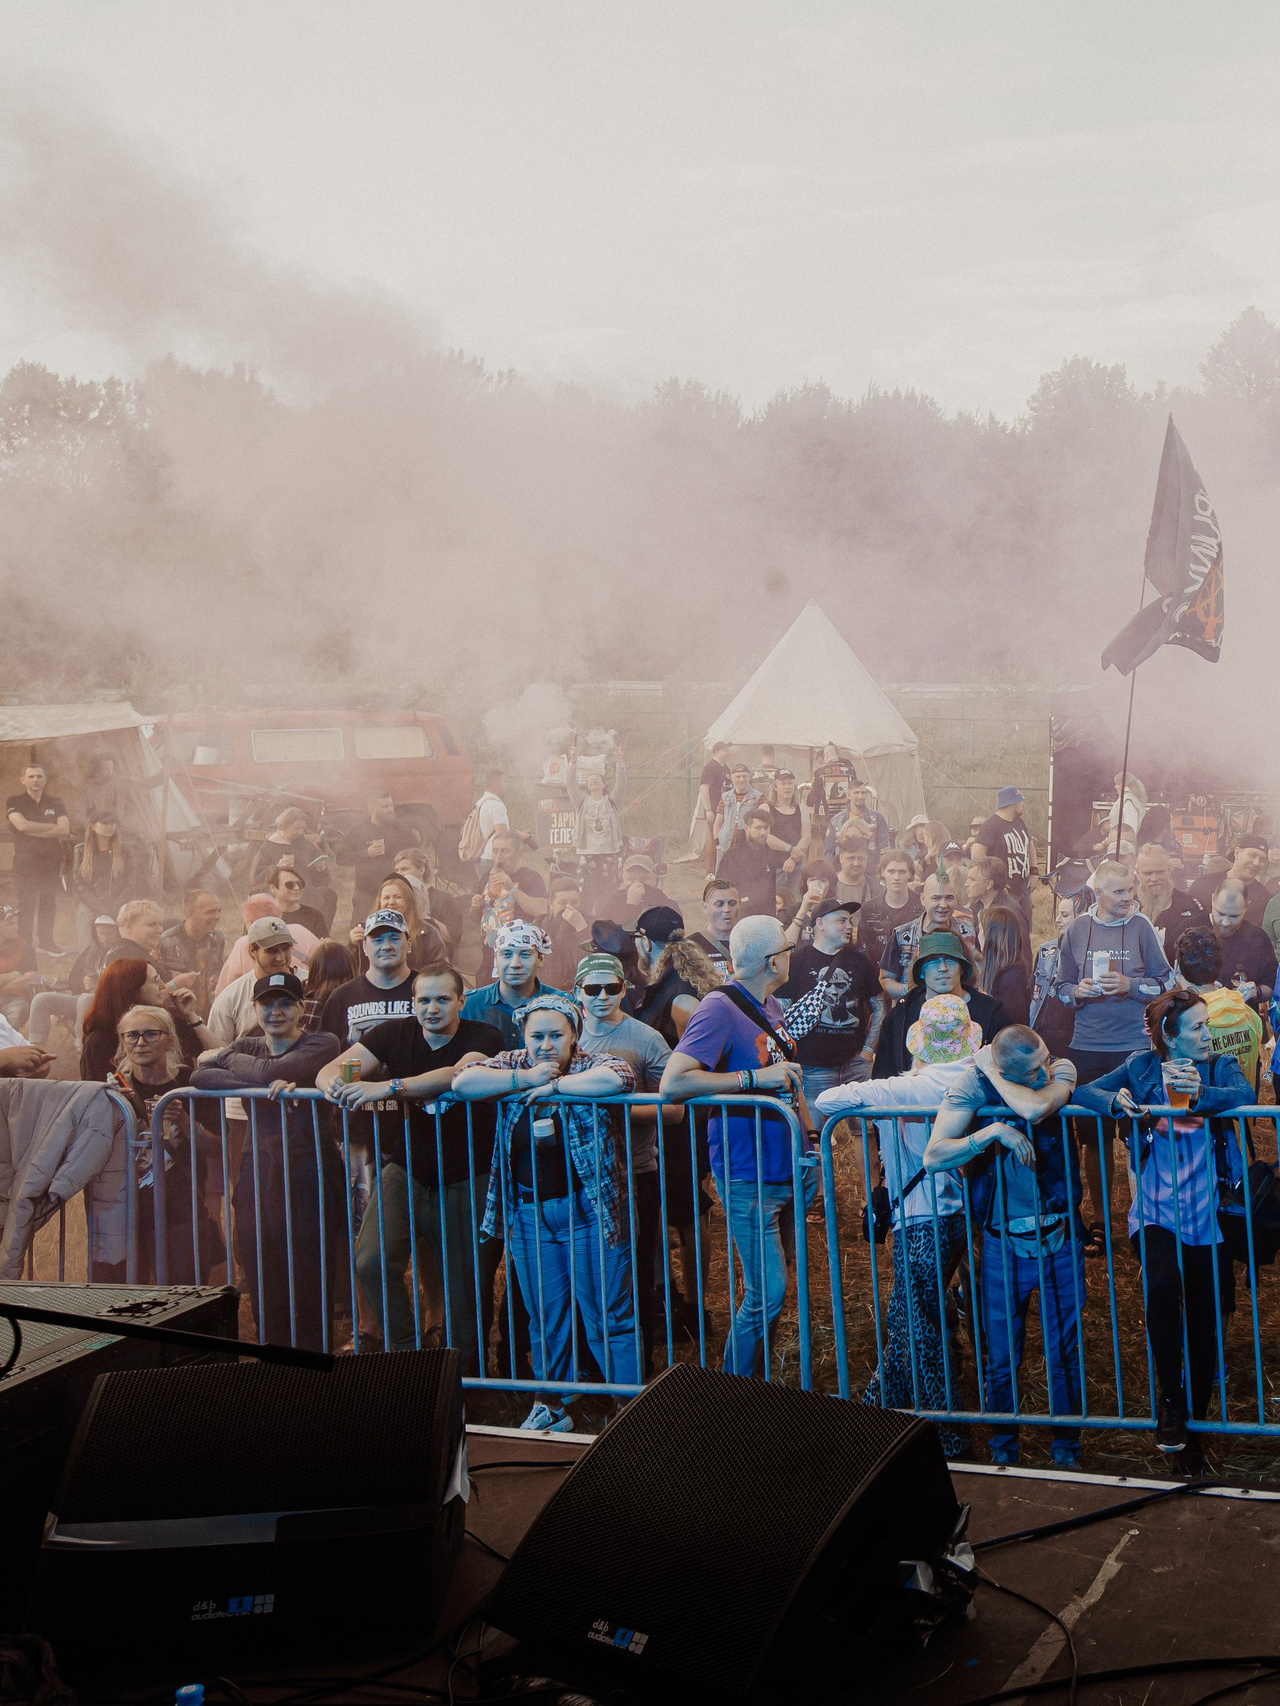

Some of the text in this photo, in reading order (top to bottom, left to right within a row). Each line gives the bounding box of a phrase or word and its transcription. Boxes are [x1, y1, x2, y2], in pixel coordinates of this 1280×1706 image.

[550, 812, 576, 828] ЗАРЯ
[549, 827, 573, 845] ТЕЛЕ
[347, 1001, 386, 1020] SOUNDS
[387, 1000, 410, 1014] LIKE
[1211, 1036, 1222, 1051] НЕ
[385, 1100, 398, 1111] GR
[192, 1599, 217, 1612] d&b
[592, 1618, 609, 1632] d&b
